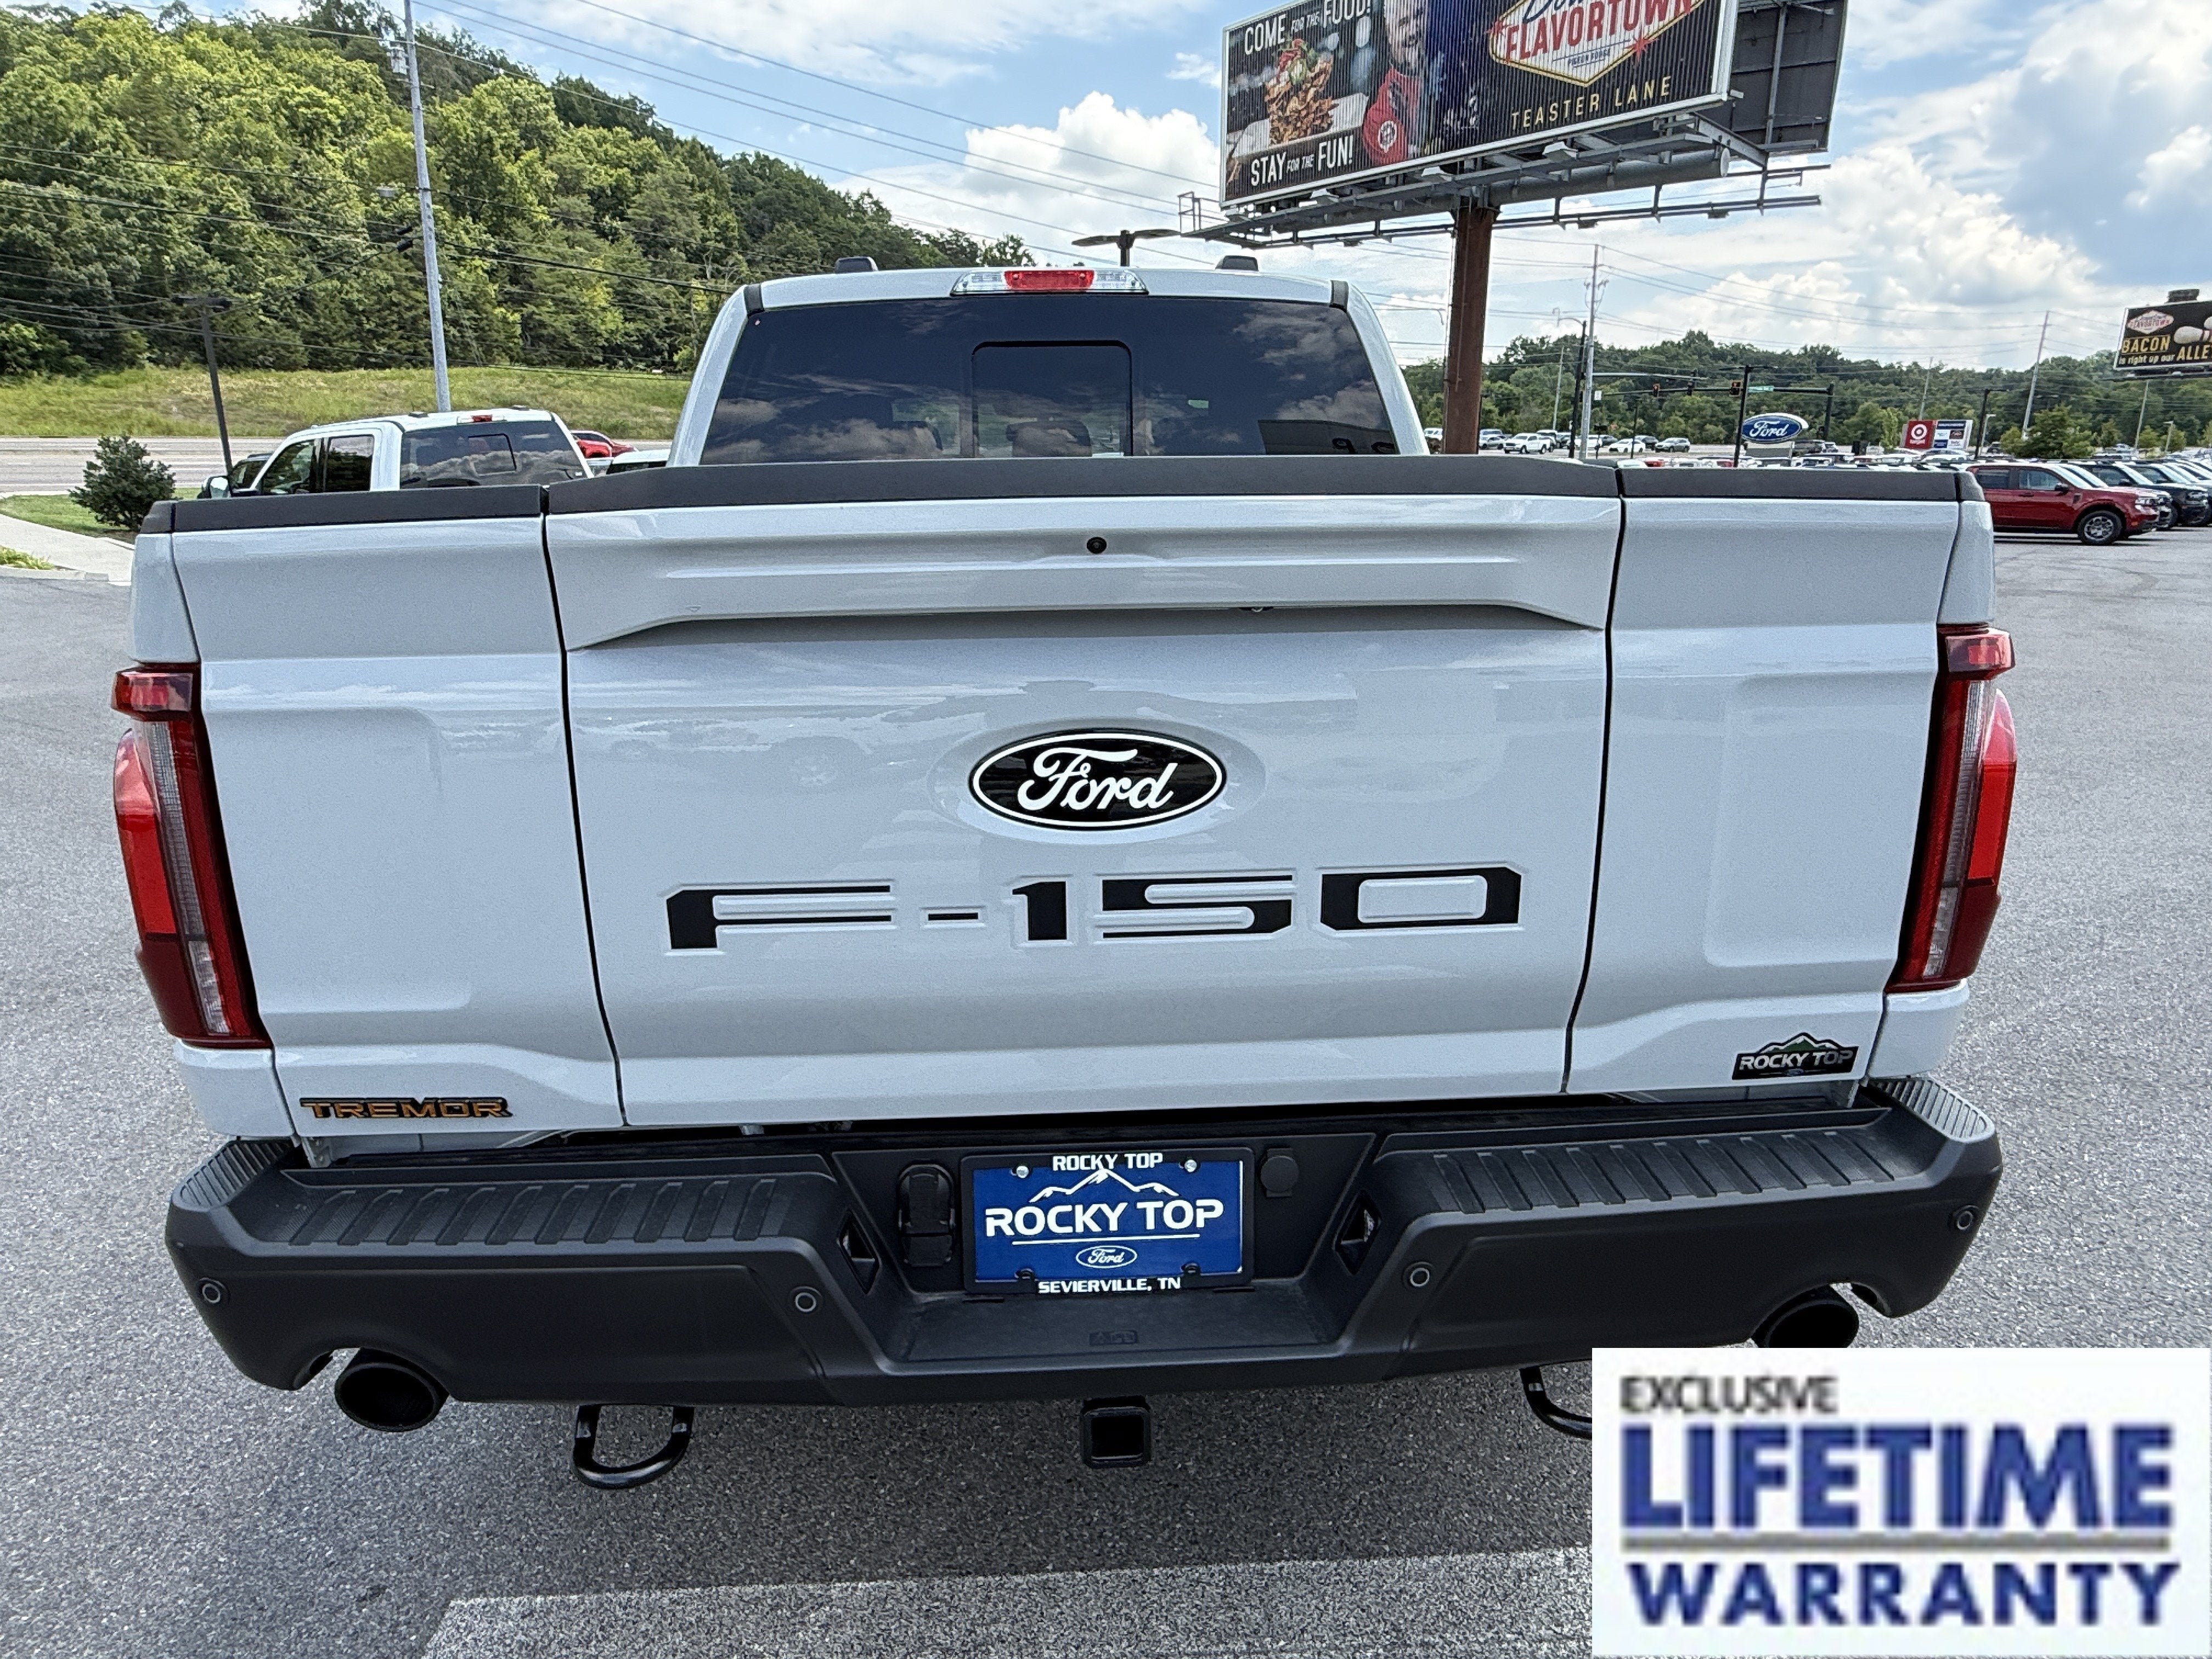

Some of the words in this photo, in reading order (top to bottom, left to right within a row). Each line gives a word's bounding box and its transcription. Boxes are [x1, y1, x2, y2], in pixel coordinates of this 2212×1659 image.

[1244, 14, 1286, 55] COME
[1291, 17, 1305, 34] FOR
[1511, 93, 1600, 130] TEASTER
[1615, 76, 1672, 106] LANE
[1251, 152, 1286, 187] STAY
[1286, 159, 1300, 174] FOR
[1301, 154, 1314, 169] THE
[1318, 135, 1353, 171] FUN!
[2121, 335, 2171, 354] BACON
[2119, 356, 2126, 365] is
[2128, 354, 2147, 365] right
[2148, 356, 2159, 364] up
[2160, 354, 2176, 362] our
[1749, 420, 1790, 437] Ford
[1017, 747, 1178, 811] Ford
[666, 866, 1522, 950] F-150
[1739, 1052, 1810, 1070] ROCKY
[1812, 1050, 1853, 1066] TOP
[299, 1096, 514, 1118] TREMOR
[1052, 1154, 1119, 1171] ROCKY
[1124, 1152, 1163, 1169] TOP
[985, 1202, 1128, 1237] ROCKY
[1136, 1199, 1224, 1230] TOP
[1087, 1248, 1125, 1264] Ford
[1038, 1278, 1152, 1294] SEVIERVILLE,
[1159, 1277, 1181, 1290] TN
